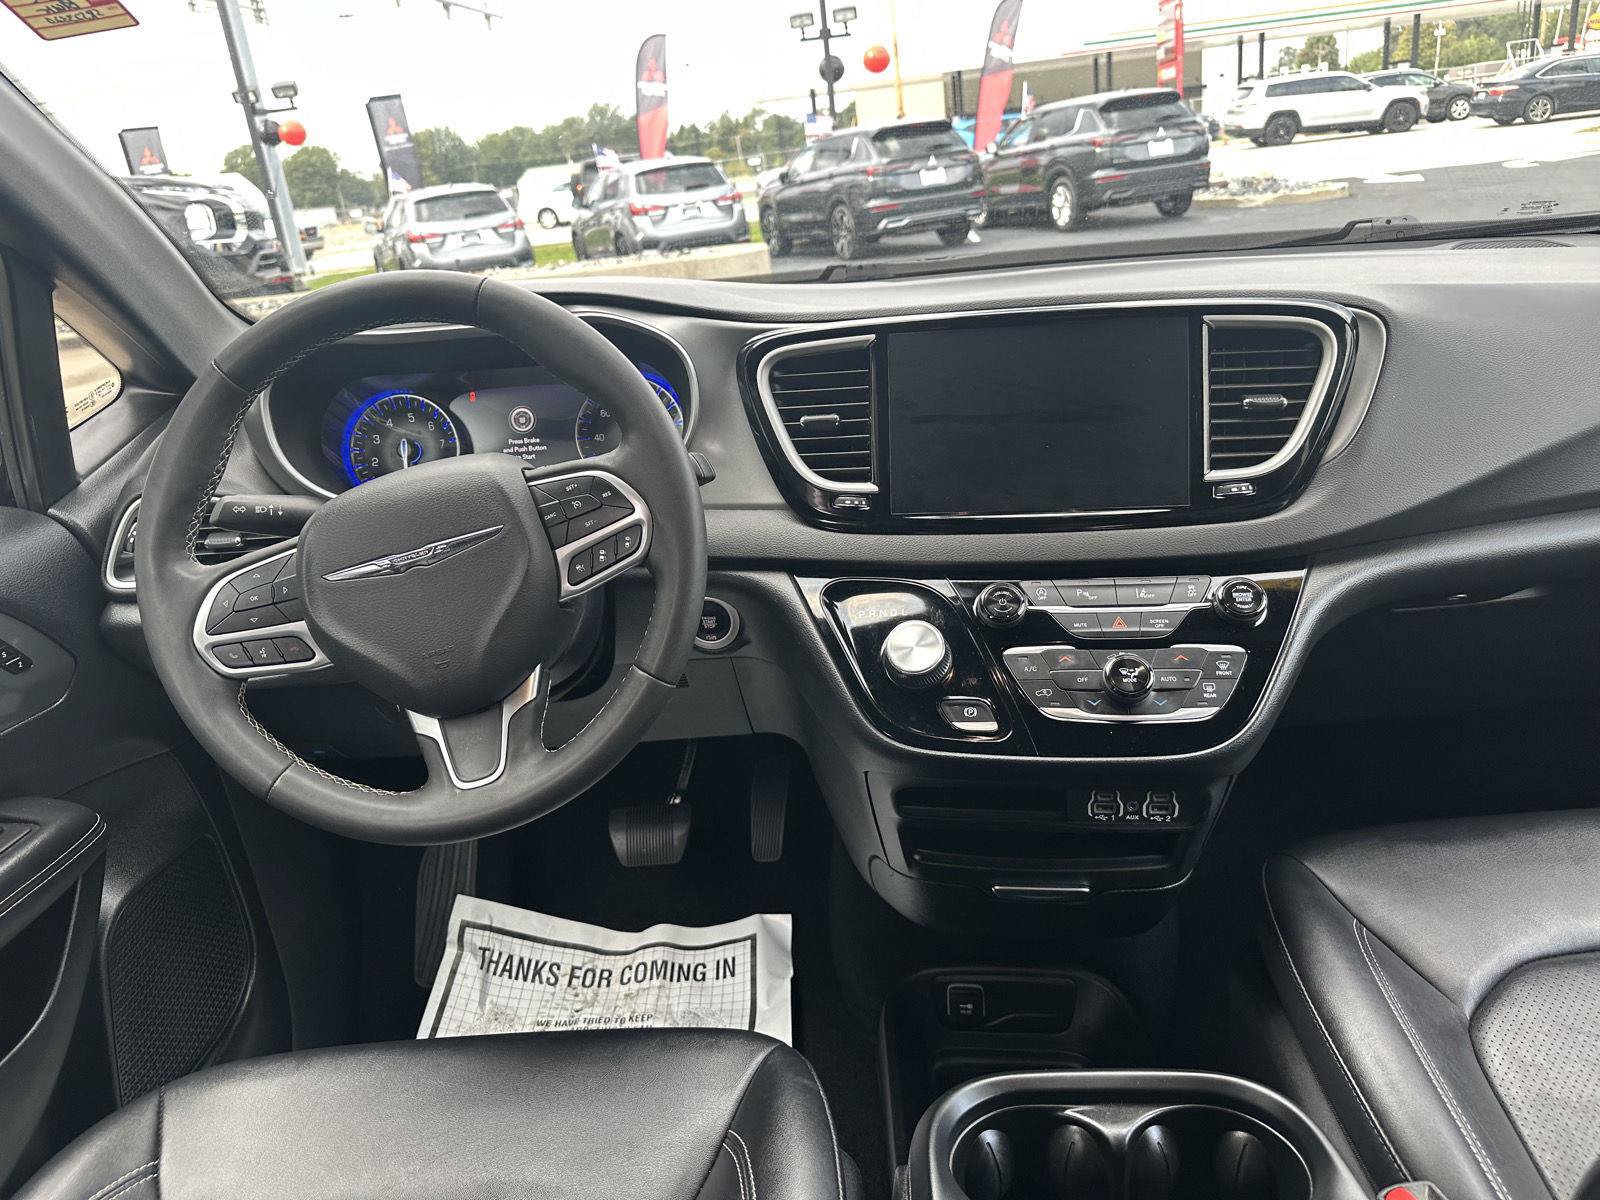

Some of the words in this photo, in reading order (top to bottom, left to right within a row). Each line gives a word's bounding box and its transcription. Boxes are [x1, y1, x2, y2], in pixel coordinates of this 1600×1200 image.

[386, 418, 393, 427] 4
[407, 412, 415, 423] 5
[428, 421, 435, 431] 6
[372, 434, 380, 444] 3
[594, 433, 605, 442] 40
[439, 439, 445, 449] 7
[371, 457, 379, 467] 2
[858, 610, 865, 618] P
[869, 609, 877, 617] R
[890, 608, 898, 616] D
[901, 608, 908, 616] L
[478, 946, 561, 987] THANKS
[567, 965, 613, 989] FOR
[619, 958, 707, 987] COMING
[715, 956, 737, 980] IN
[536, 1018, 552, 1027] WE
[582, 1016, 611, 1025] TRIED
[614, 1016, 626, 1025] TO
[628, 1013, 654, 1023] KEEP
